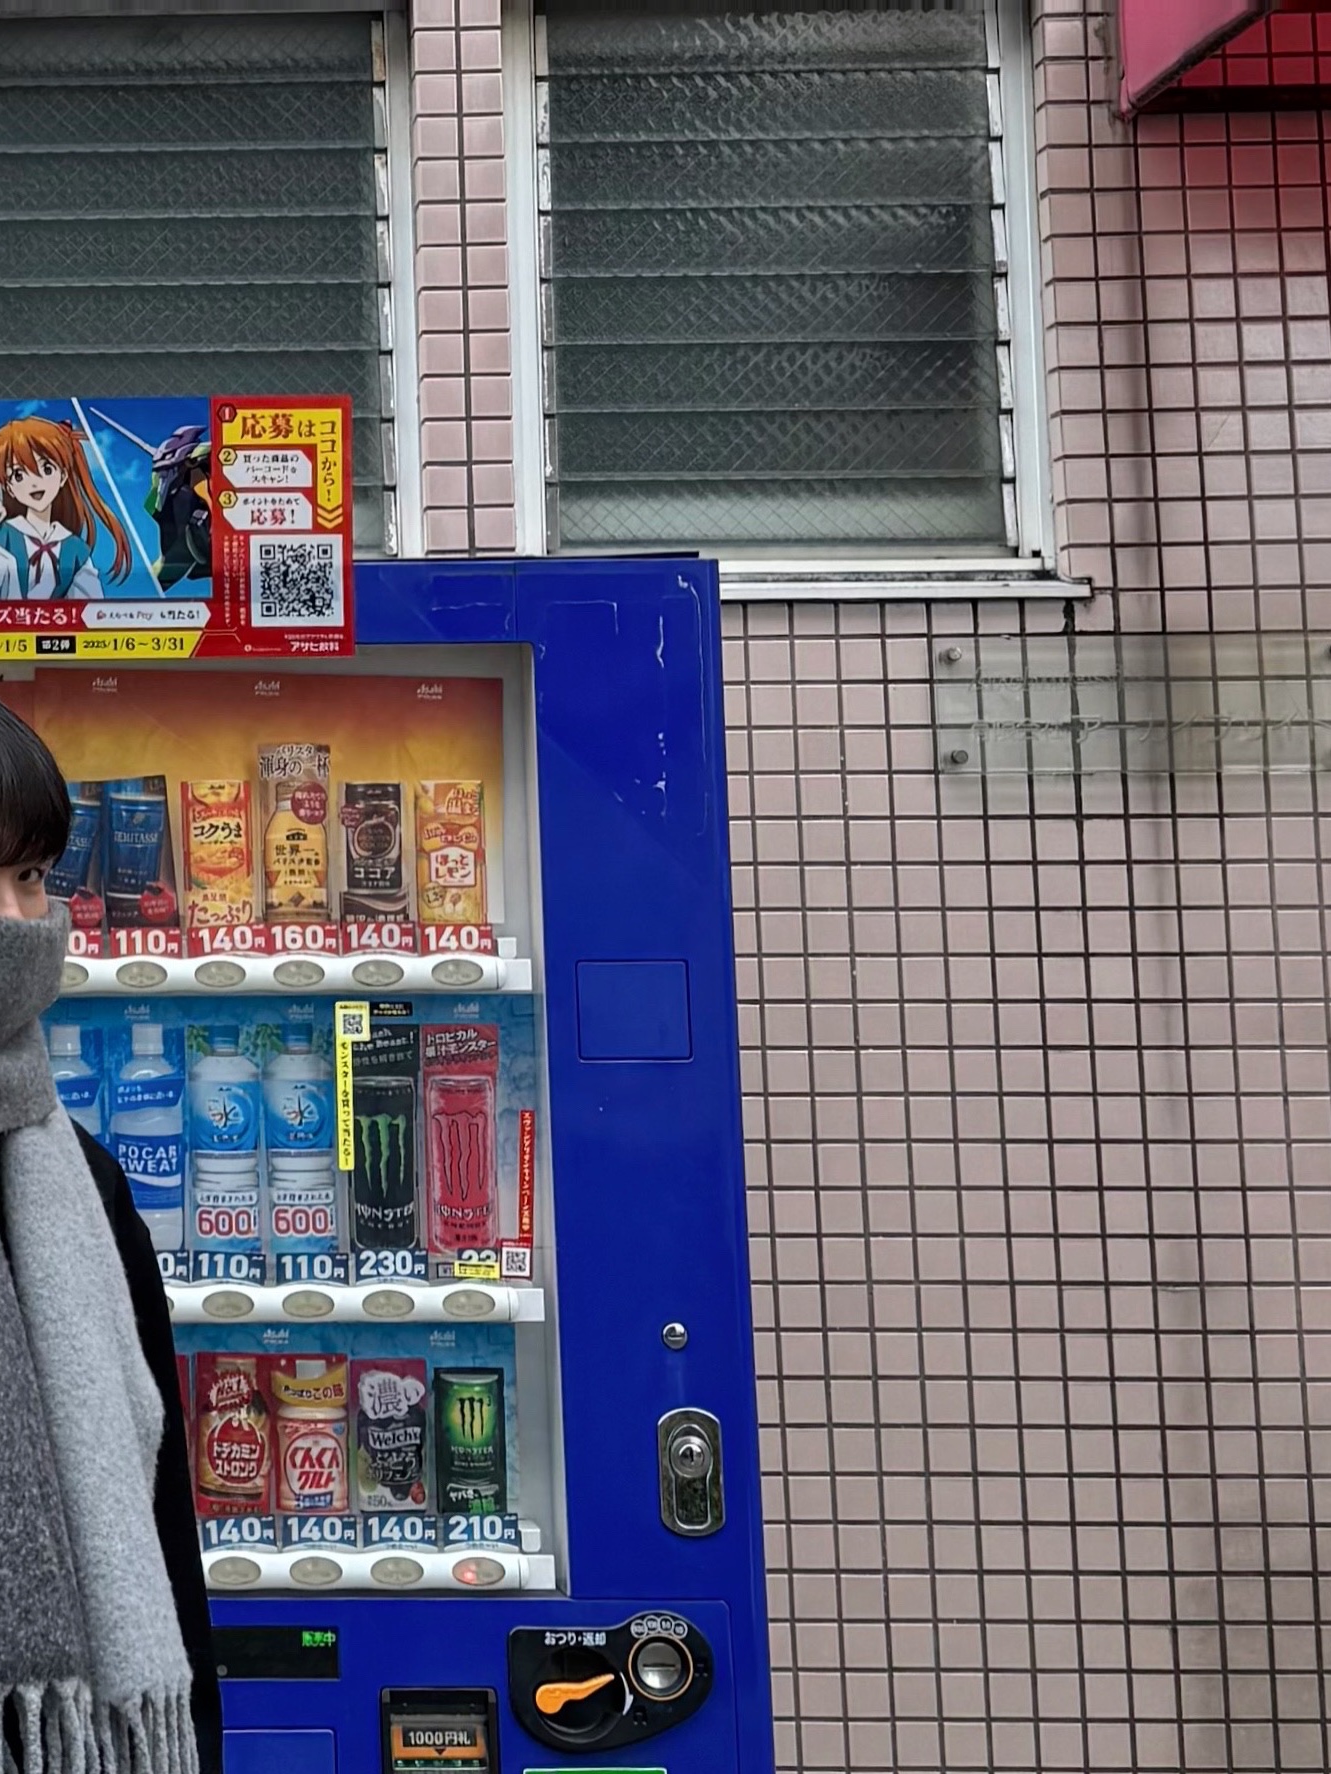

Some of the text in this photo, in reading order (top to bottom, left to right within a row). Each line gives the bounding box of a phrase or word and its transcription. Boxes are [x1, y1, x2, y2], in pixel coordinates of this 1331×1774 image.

[240, 413, 316, 440] 応募は
[222, 450, 233, 463] 2
[222, 492, 233, 506] 3
[193, 822, 243, 839] コクうま
[354, 866, 396, 879] ココア
[435, 866, 471, 879] レモン
[187, 900, 254, 925] たっぷり
[115, 929, 178, 955] 110円
[198, 925, 265, 953] 140円
[270, 924, 337, 950] 160円
[346, 923, 413, 949] 140円
[424, 926, 492, 951] 140円
[426, 1028, 478, 1045] トロピカル
[118, 1158, 177, 1173] SWEAT
[198, 1253, 261, 1279] 110円
[281, 1254, 345, 1279] 110円
[359, 1250, 426, 1276] 230円
[367, 1378, 419, 1417] 濃い
[287, 1517, 355, 1542] 140円
[367, 1516, 436, 1542] 140円
[448, 1515, 516, 1542] 210円
[544, 1631, 607, 1646] おつり・返却
[408, 1731, 471, 1745] 1000円札
